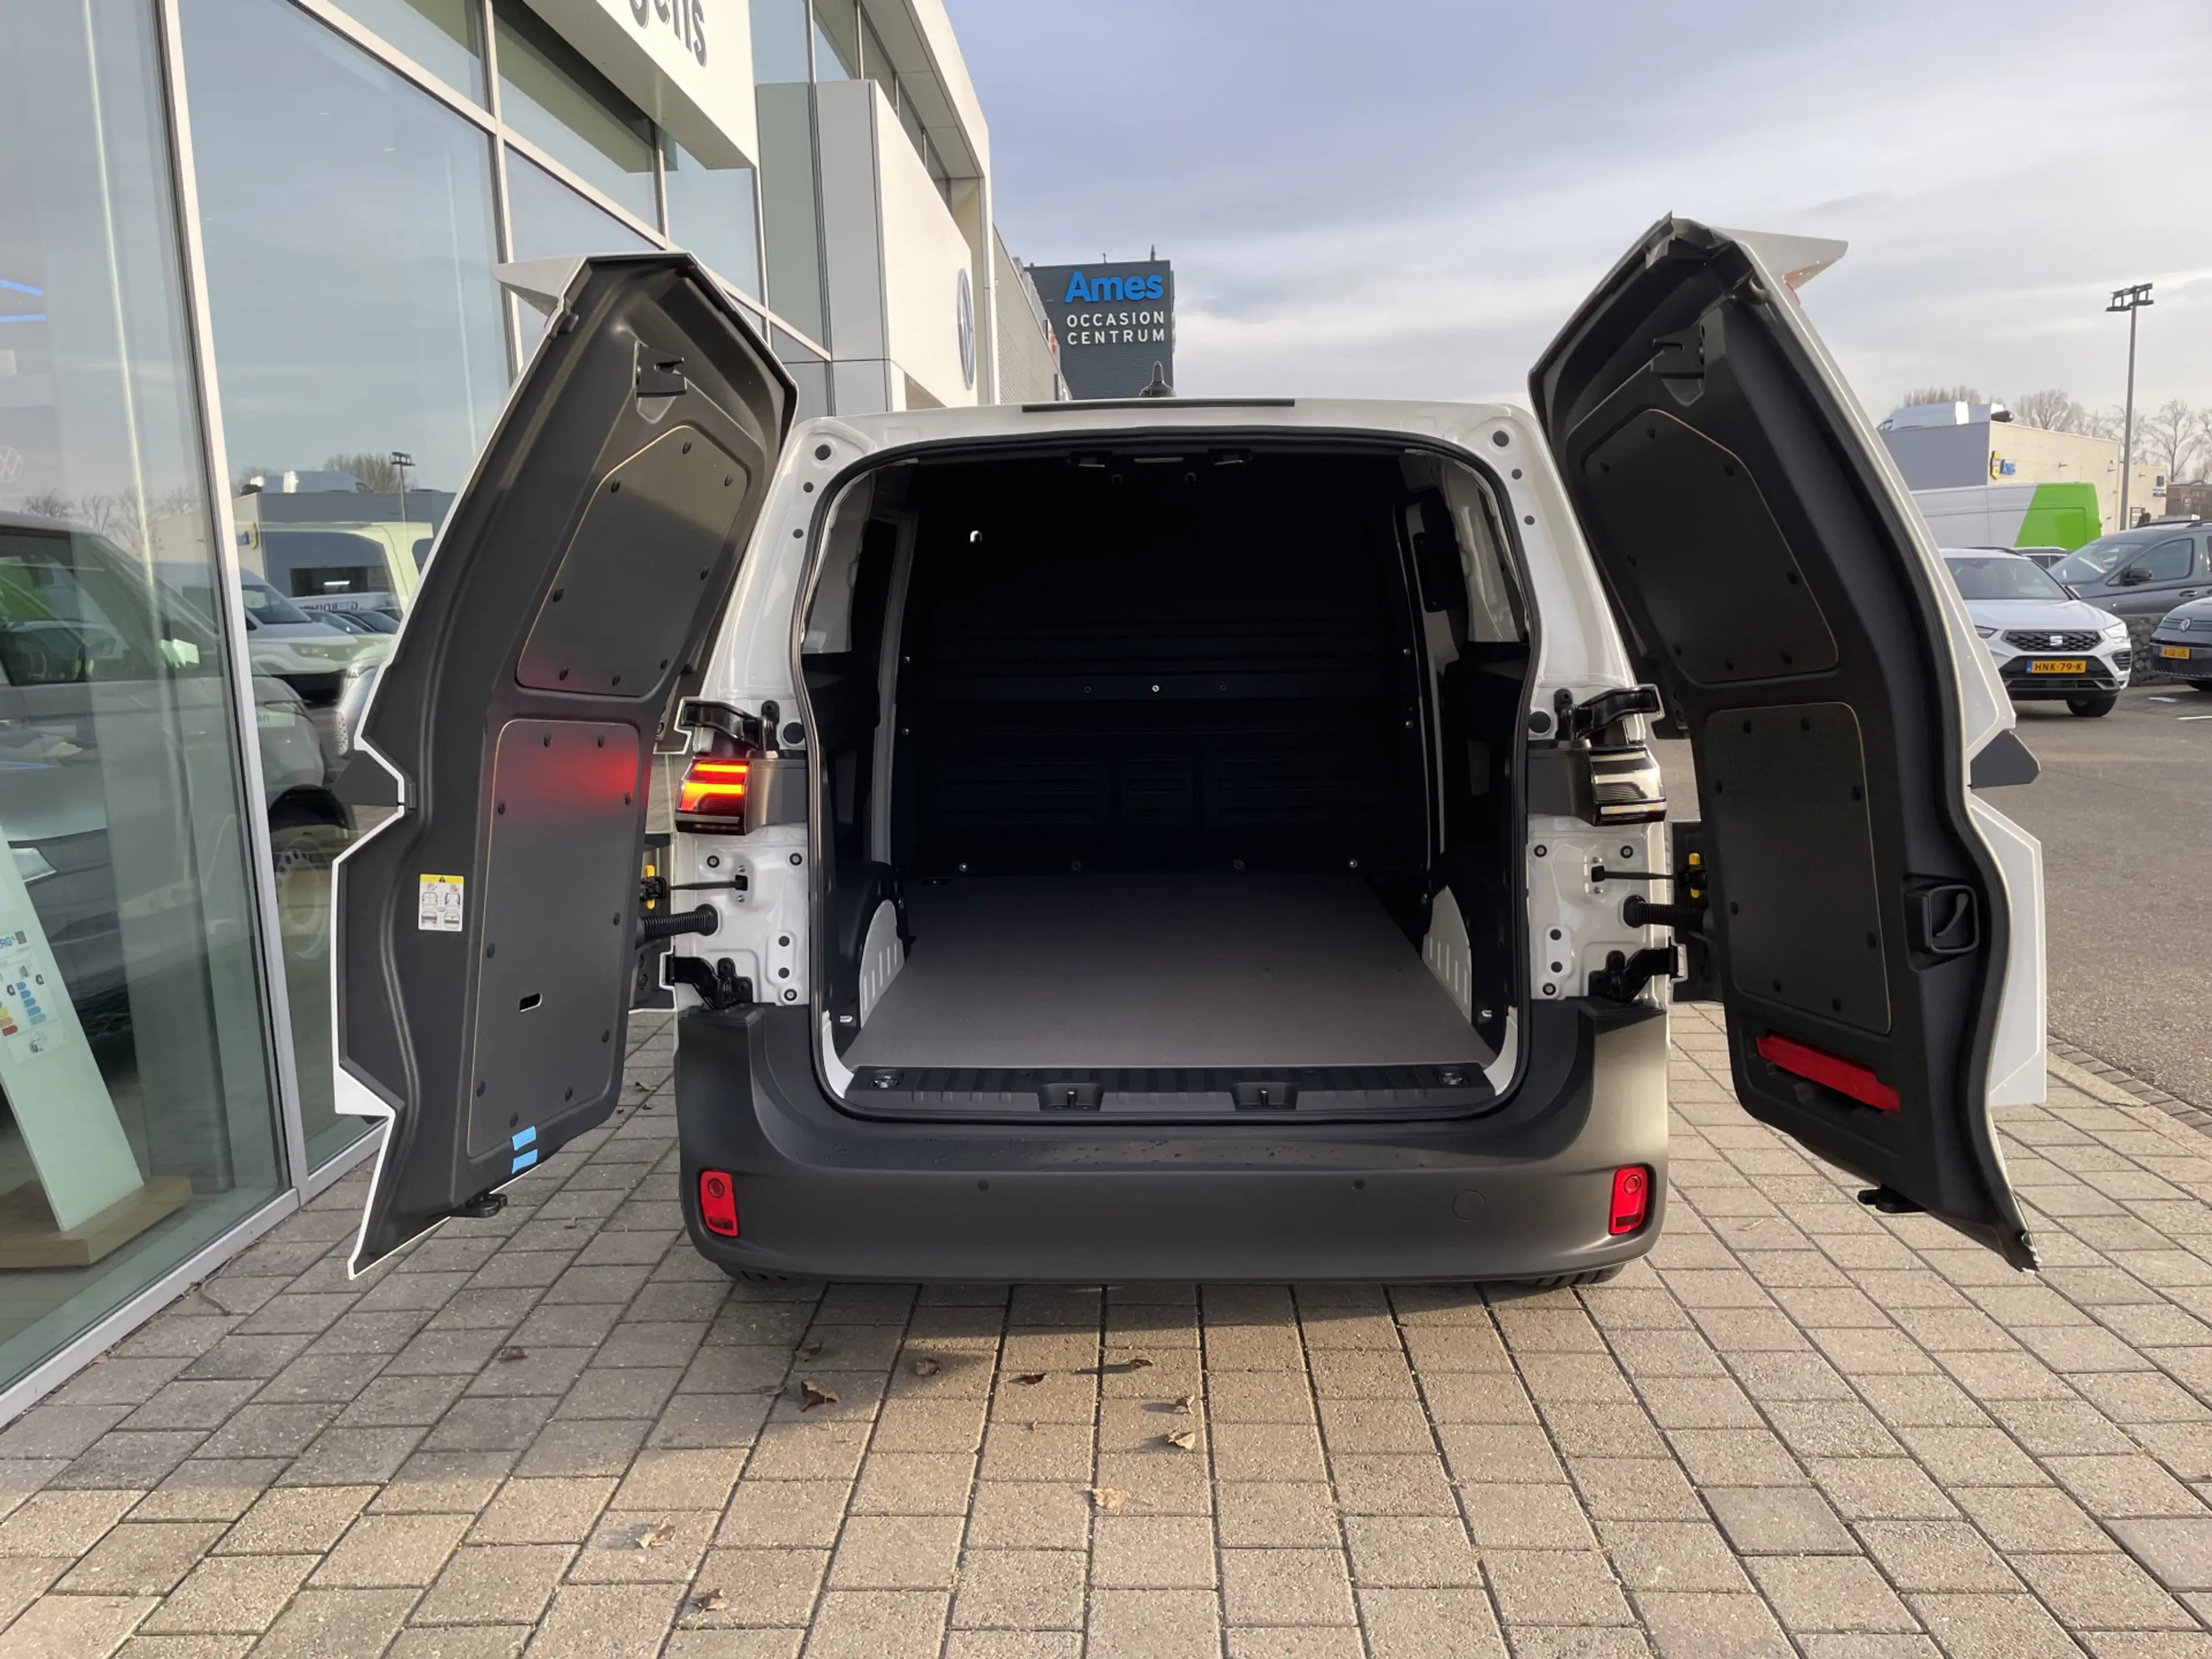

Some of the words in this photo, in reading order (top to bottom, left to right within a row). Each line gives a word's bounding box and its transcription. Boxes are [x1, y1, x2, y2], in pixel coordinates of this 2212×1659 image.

[1065, 271, 1164, 302] Ames
[1067, 311, 1164, 327] OCCASION
[1067, 328, 1164, 345] CENTRUM
[2034, 662, 2082, 671] HNK-79-K
